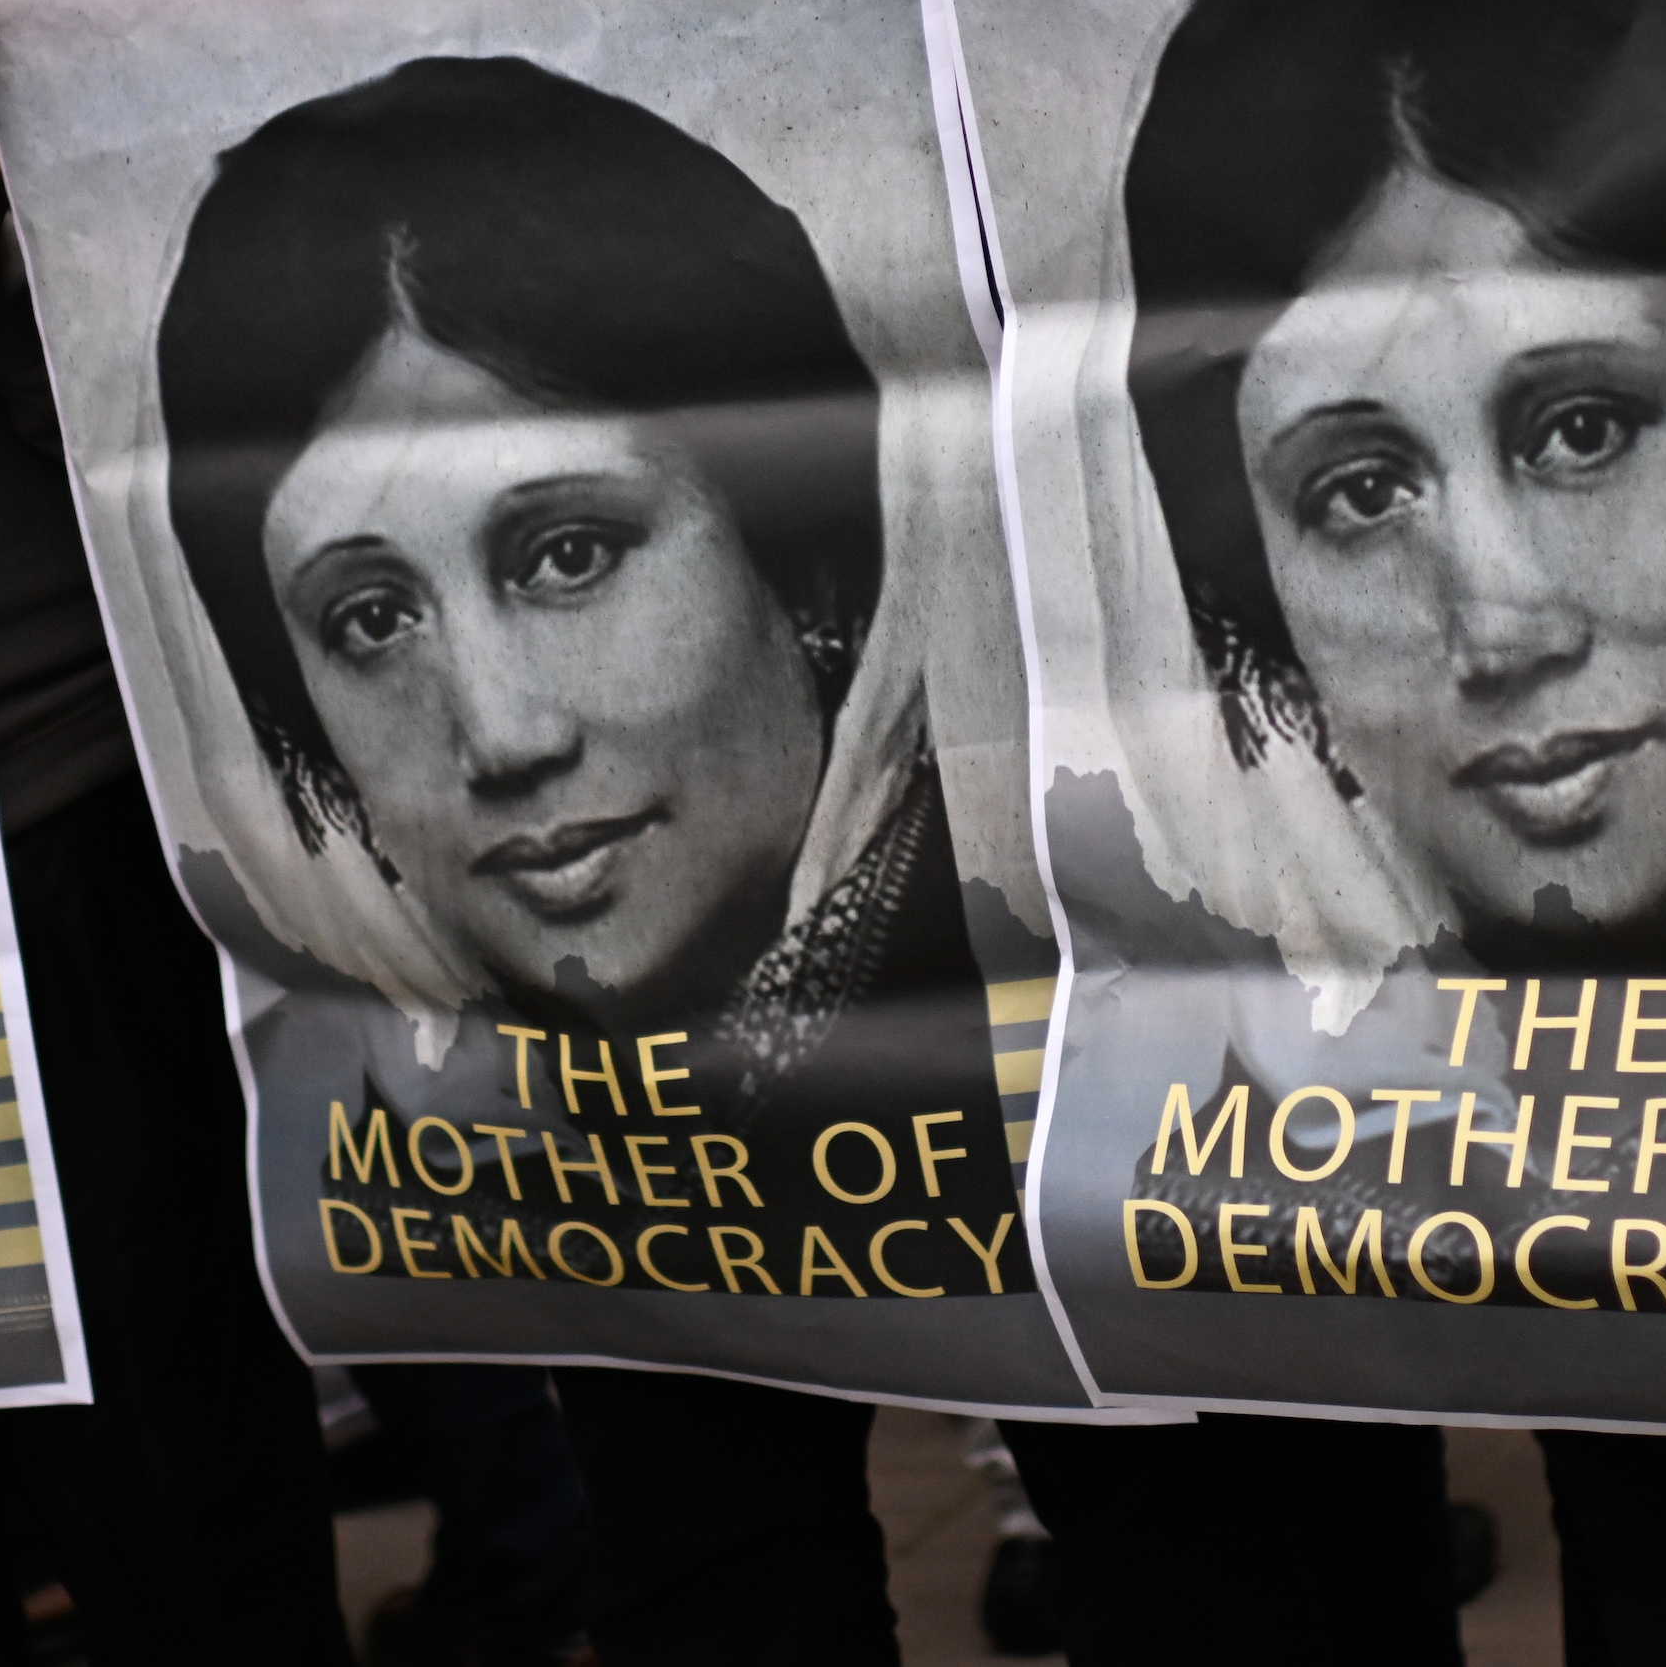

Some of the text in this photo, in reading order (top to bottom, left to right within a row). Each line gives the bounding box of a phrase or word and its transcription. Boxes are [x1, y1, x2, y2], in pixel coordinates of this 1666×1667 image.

[496, 1022, 703, 1118] THE
[329, 1100, 968, 1208] MOTHER OF
[318, 1198, 1016, 1300] DEMOCRACY
